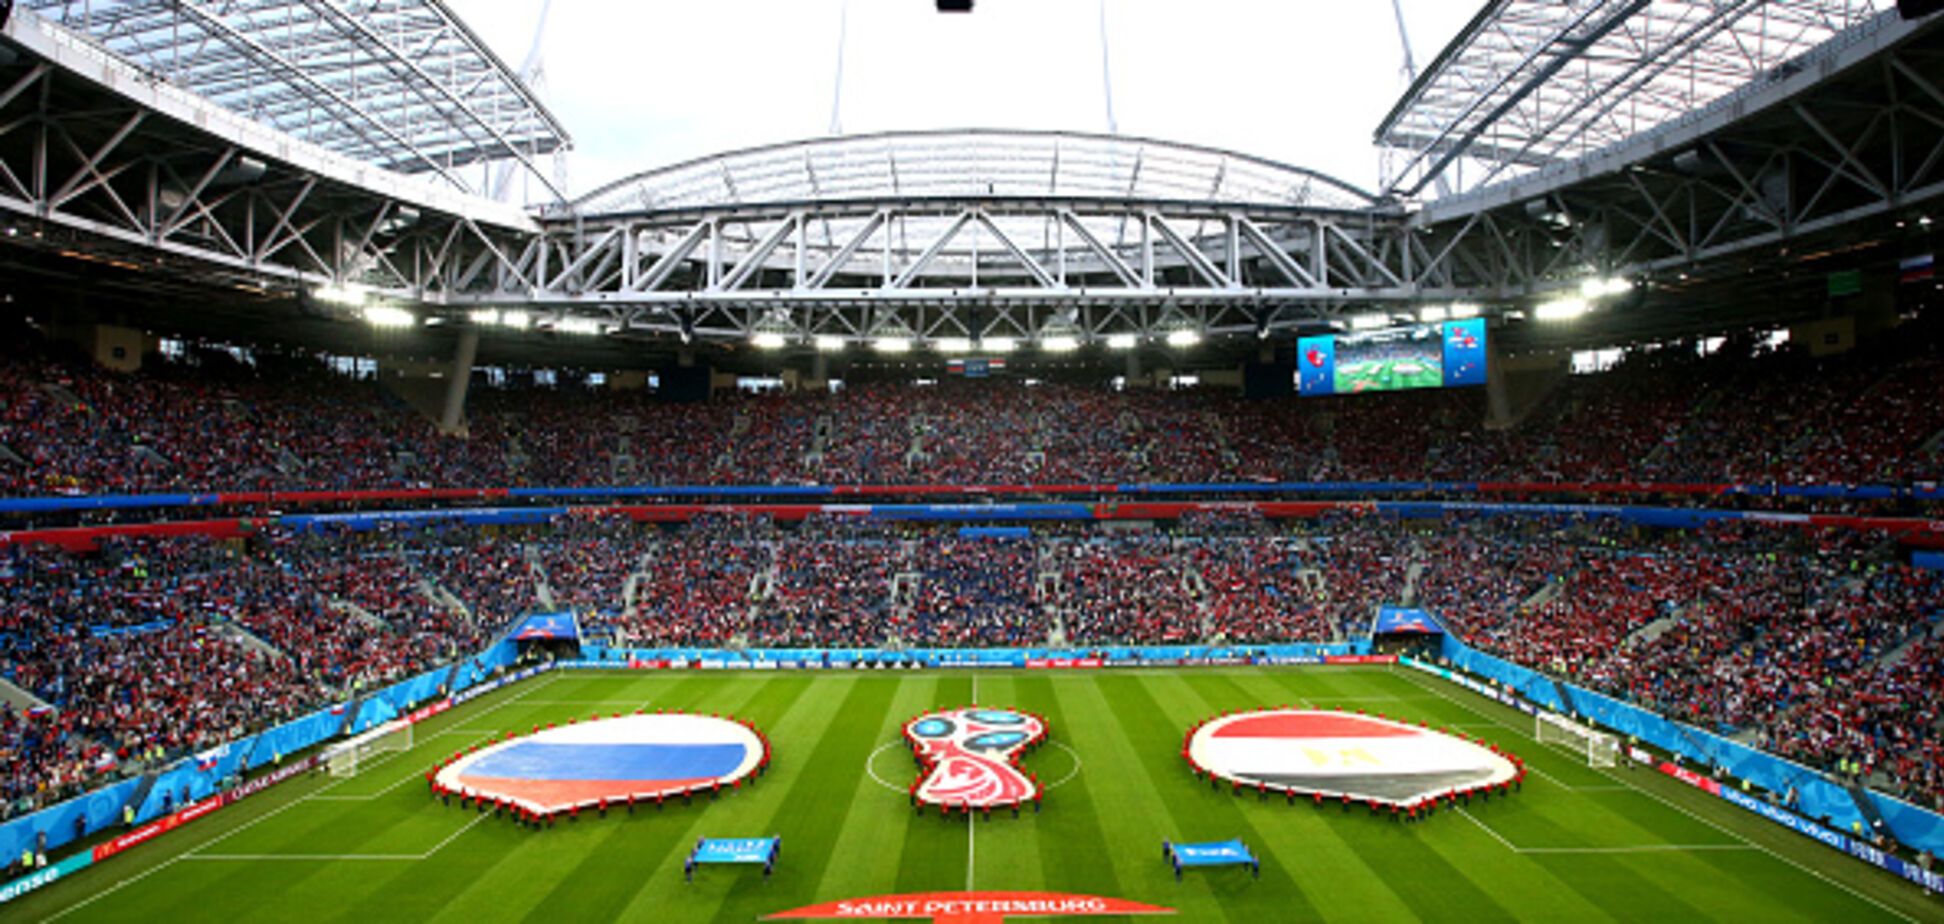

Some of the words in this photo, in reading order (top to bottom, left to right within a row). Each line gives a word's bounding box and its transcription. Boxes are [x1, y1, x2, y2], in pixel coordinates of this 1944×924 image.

[1761, 806, 1796, 827] vivo
[1801, 823, 1839, 846] vivo
[836, 900, 918, 914] SAINT
[925, 898, 1107, 913] PETERSBURG
